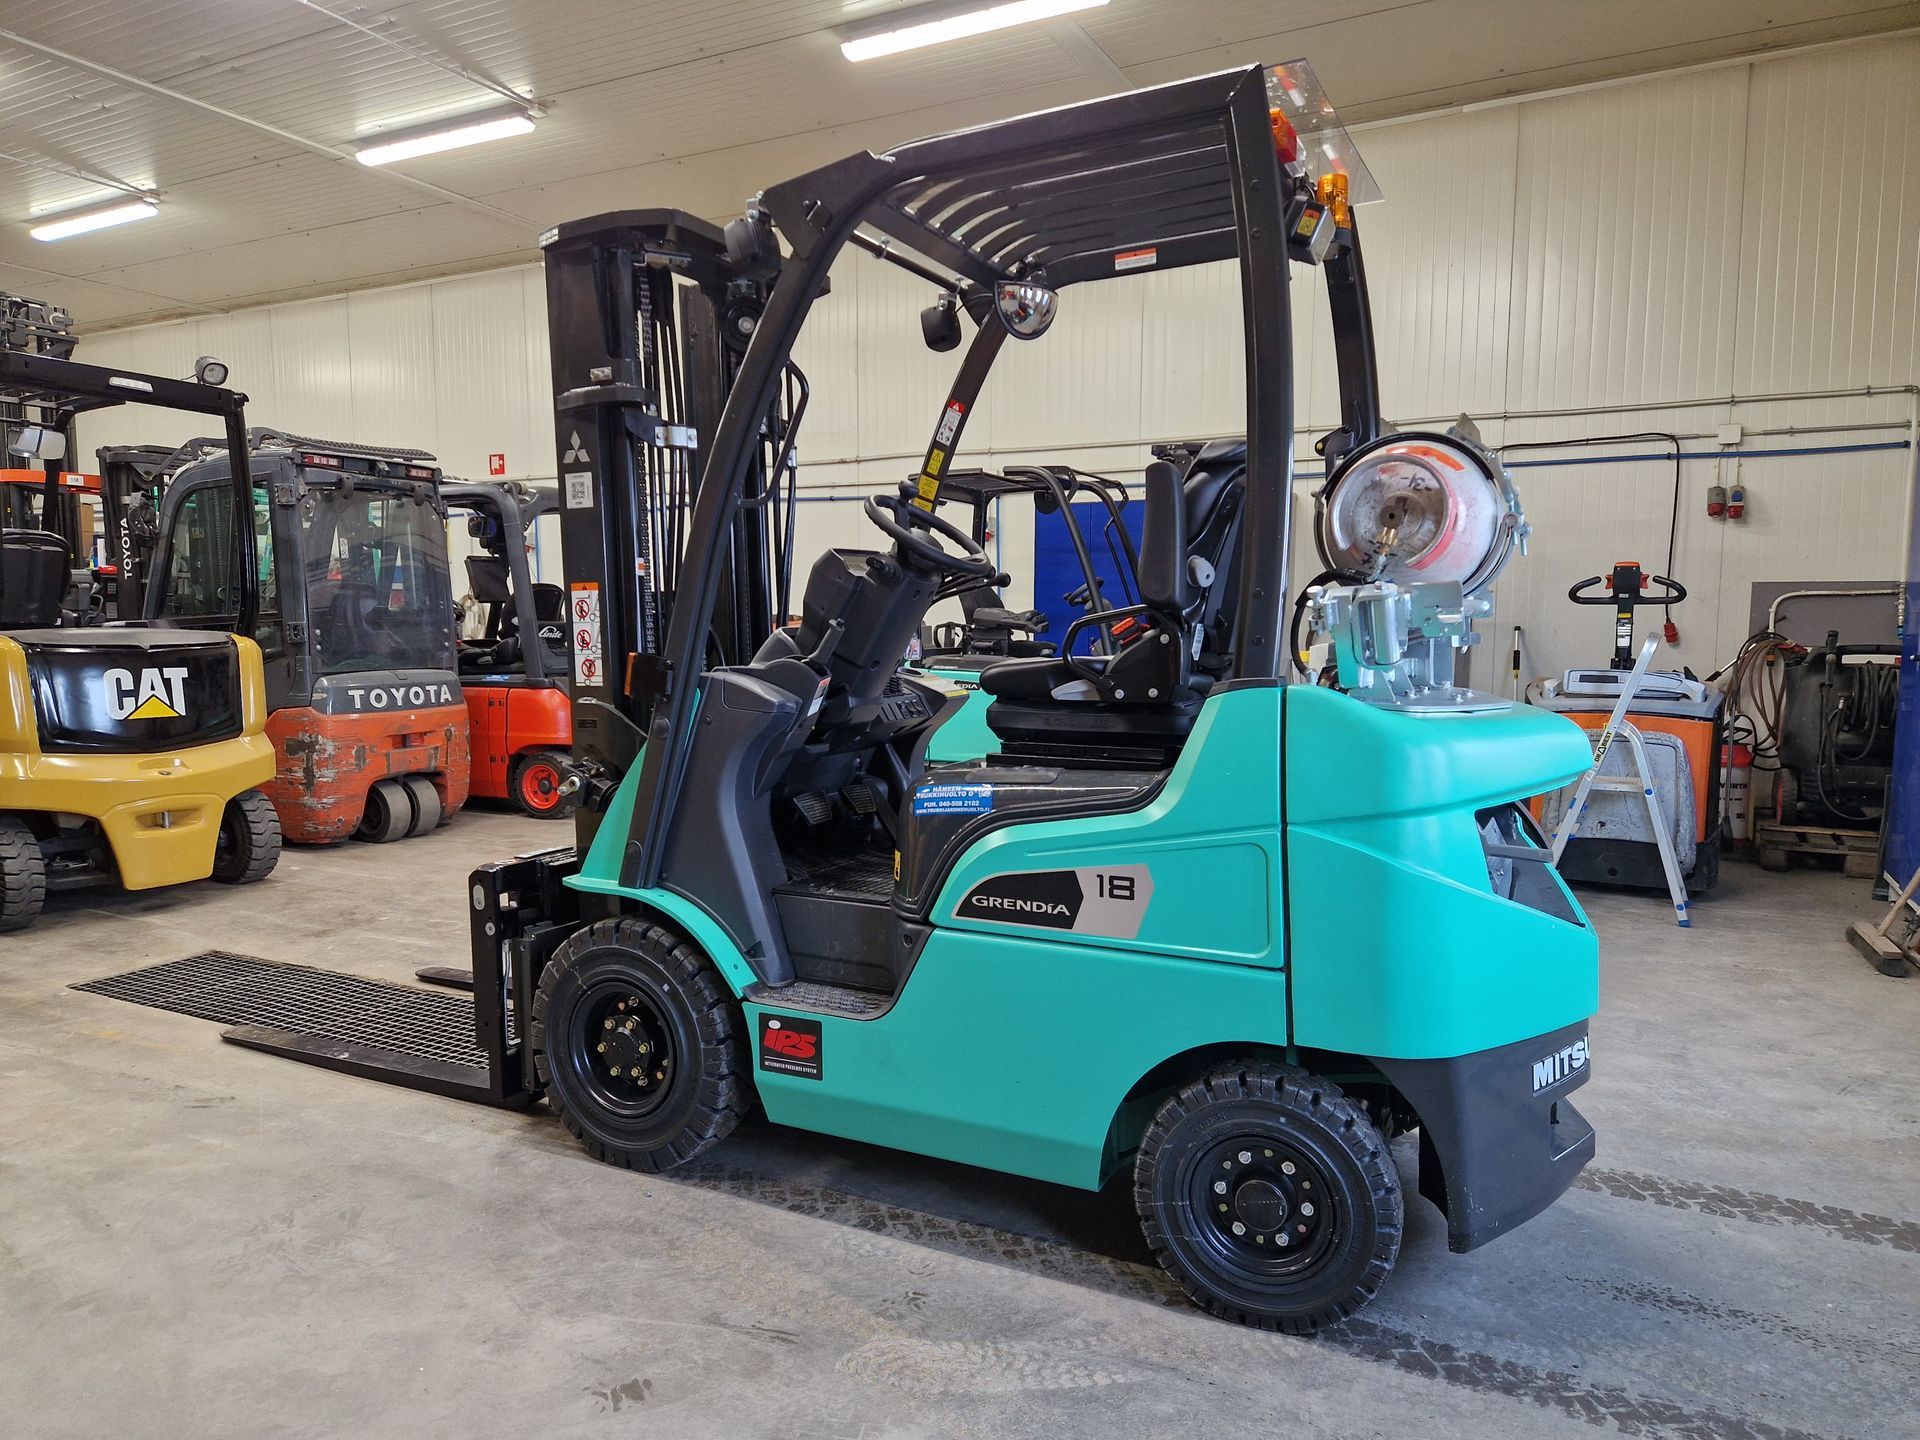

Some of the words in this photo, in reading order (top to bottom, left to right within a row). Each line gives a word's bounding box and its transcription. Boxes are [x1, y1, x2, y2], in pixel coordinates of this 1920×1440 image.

[120, 517, 133, 580] TOYOTA
[103, 667, 189, 720] CAT
[347, 684, 453, 709] TOYOTA
[1096, 873, 1136, 901] 18
